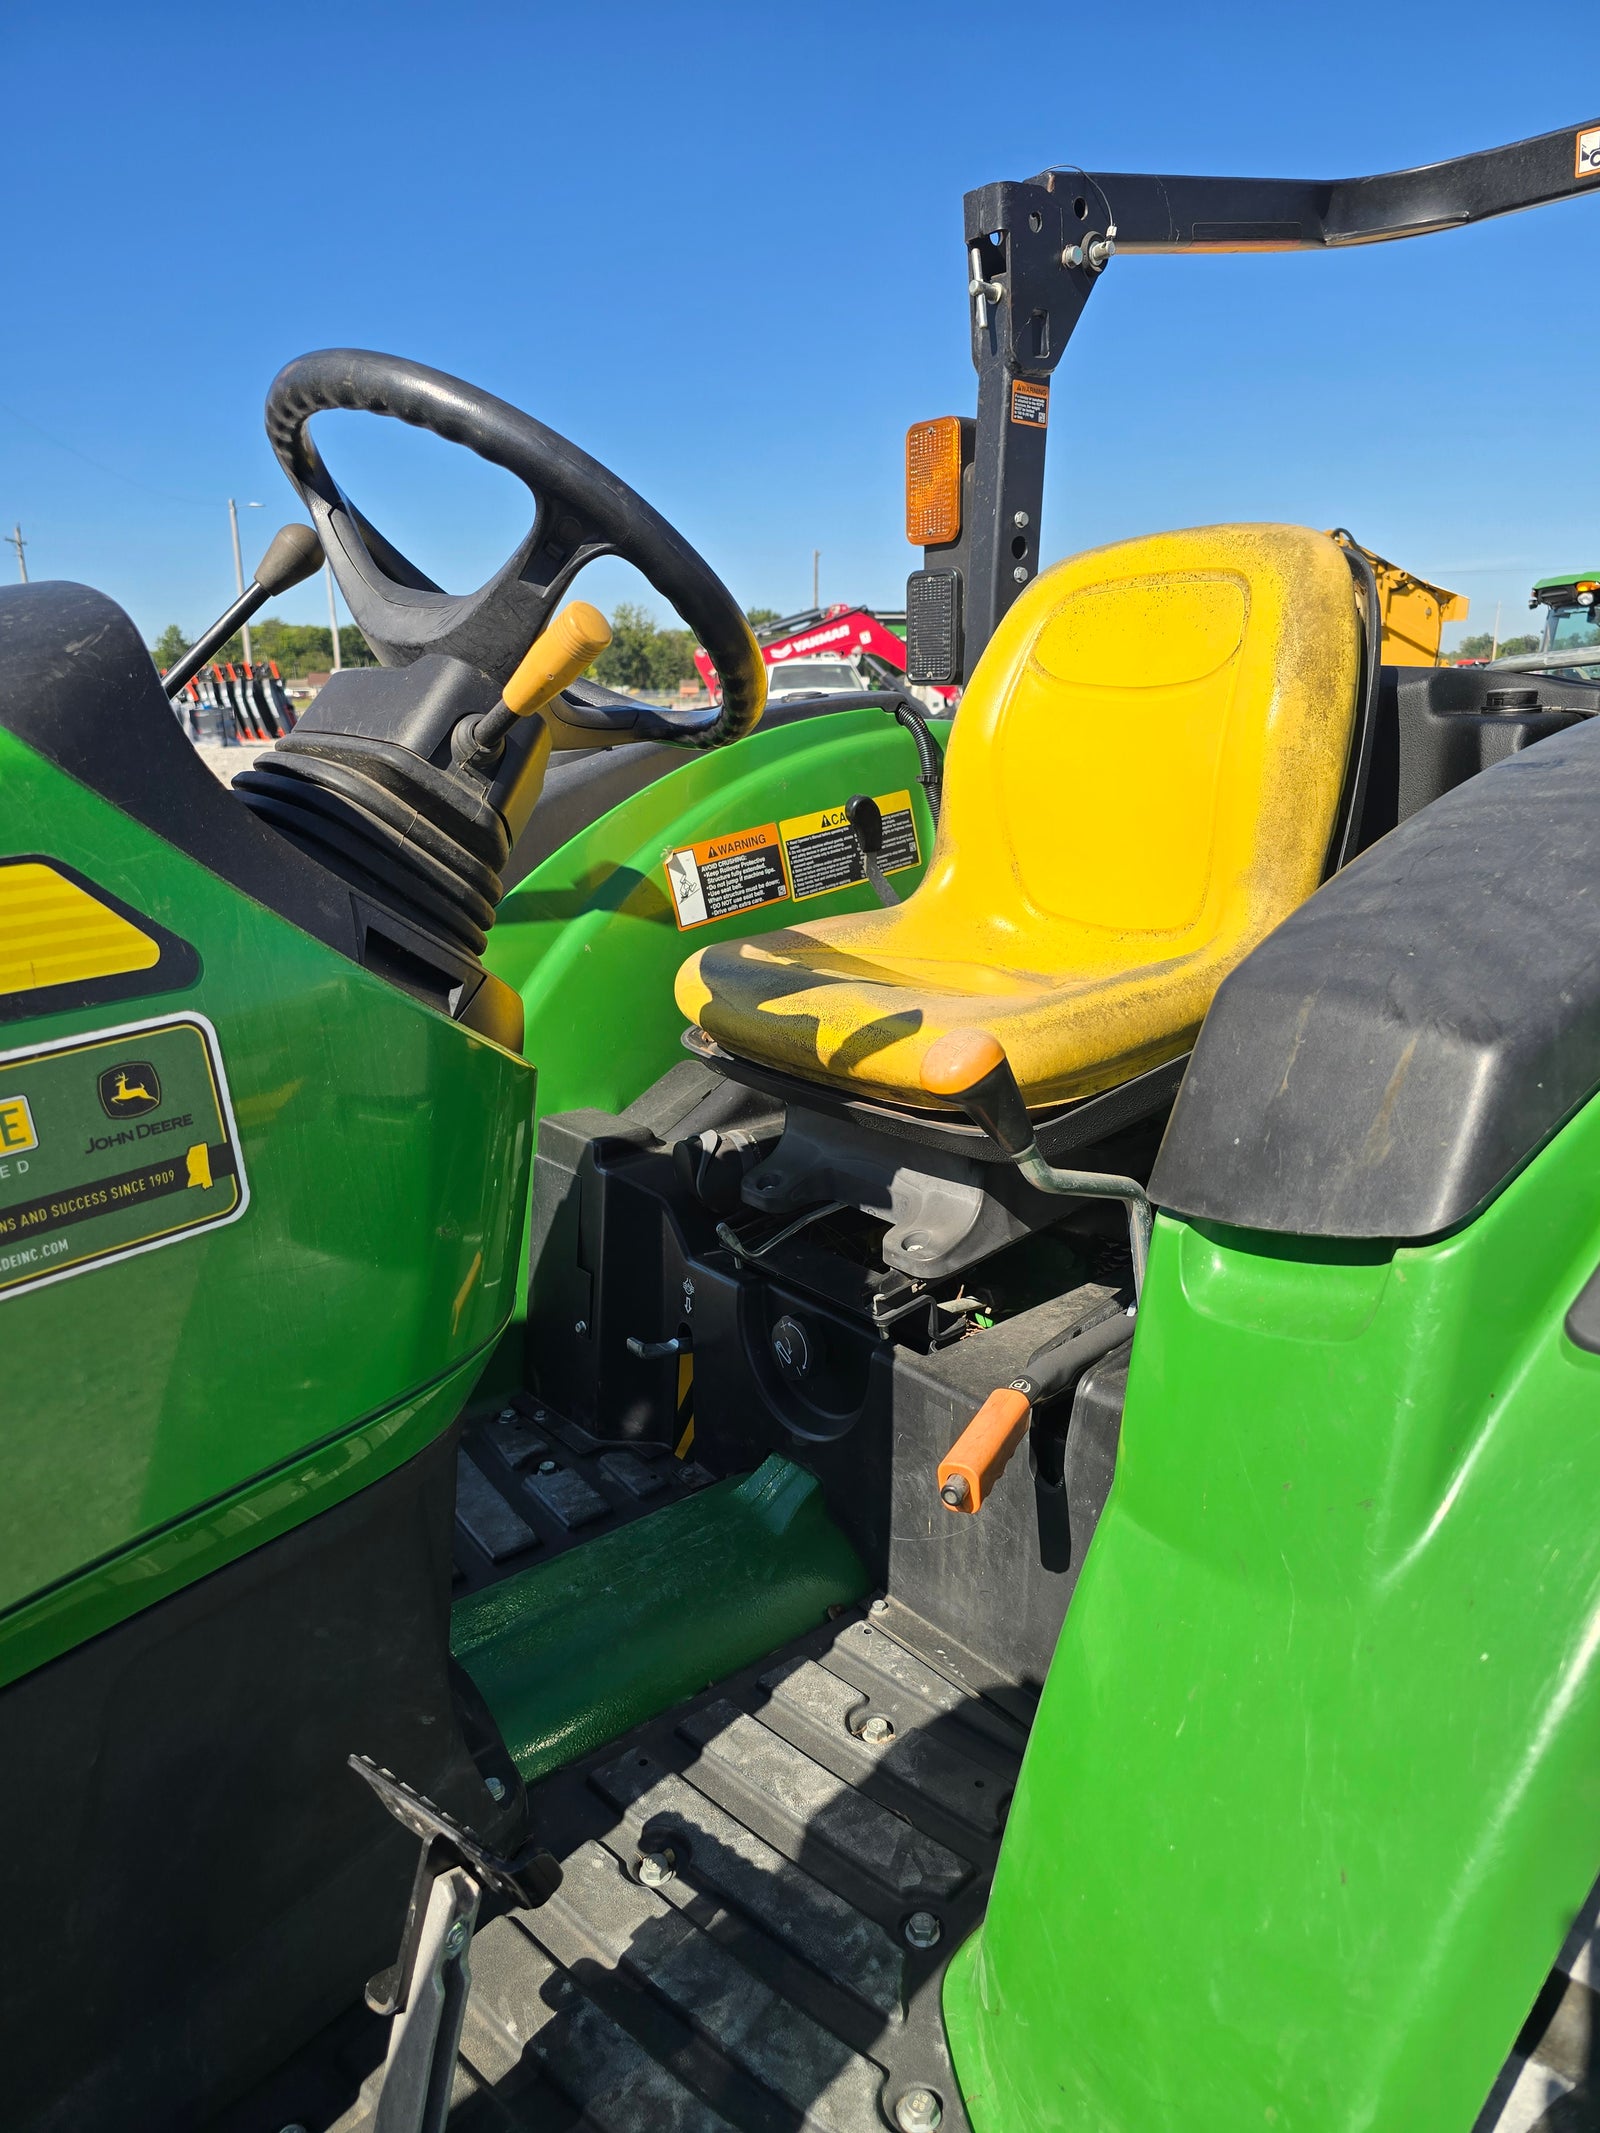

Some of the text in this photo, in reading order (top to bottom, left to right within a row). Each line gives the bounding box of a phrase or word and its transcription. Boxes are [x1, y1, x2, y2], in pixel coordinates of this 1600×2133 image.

[792, 624, 851, 653] YANMAR
[717, 834, 767, 856] WARNING
[701, 855, 747, 872] AVOID CRUSHING:
[706, 856, 766, 878] Keep Rollover Protective
[707, 862, 767, 884] Structure fully extended.
[716, 881, 726, 889] not
[725, 878, 739, 887] jump
[743, 870, 765, 881] machine
[720, 886, 732, 894] seat
[707, 895, 722, 904] When
[723, 889, 746, 900] structure
[745, 884, 758, 893] must
[721, 898, 733, 907] NOT
[742, 892, 754, 901] seat
[713, 907, 728, 916] Drive
[738, 900, 752, 909] extra
[0, 1107, 26, 1147] E
[85, 1113, 194, 1155] JOHN DEERE
[20, 1208, 48, 1228] AND
[51, 1190, 108, 1218] SUCCESS
[110, 1178, 146, 1200] SINCE
[149, 1169, 175, 1188] 1909
[0, 1238, 69, 1272] DEINC.COM
